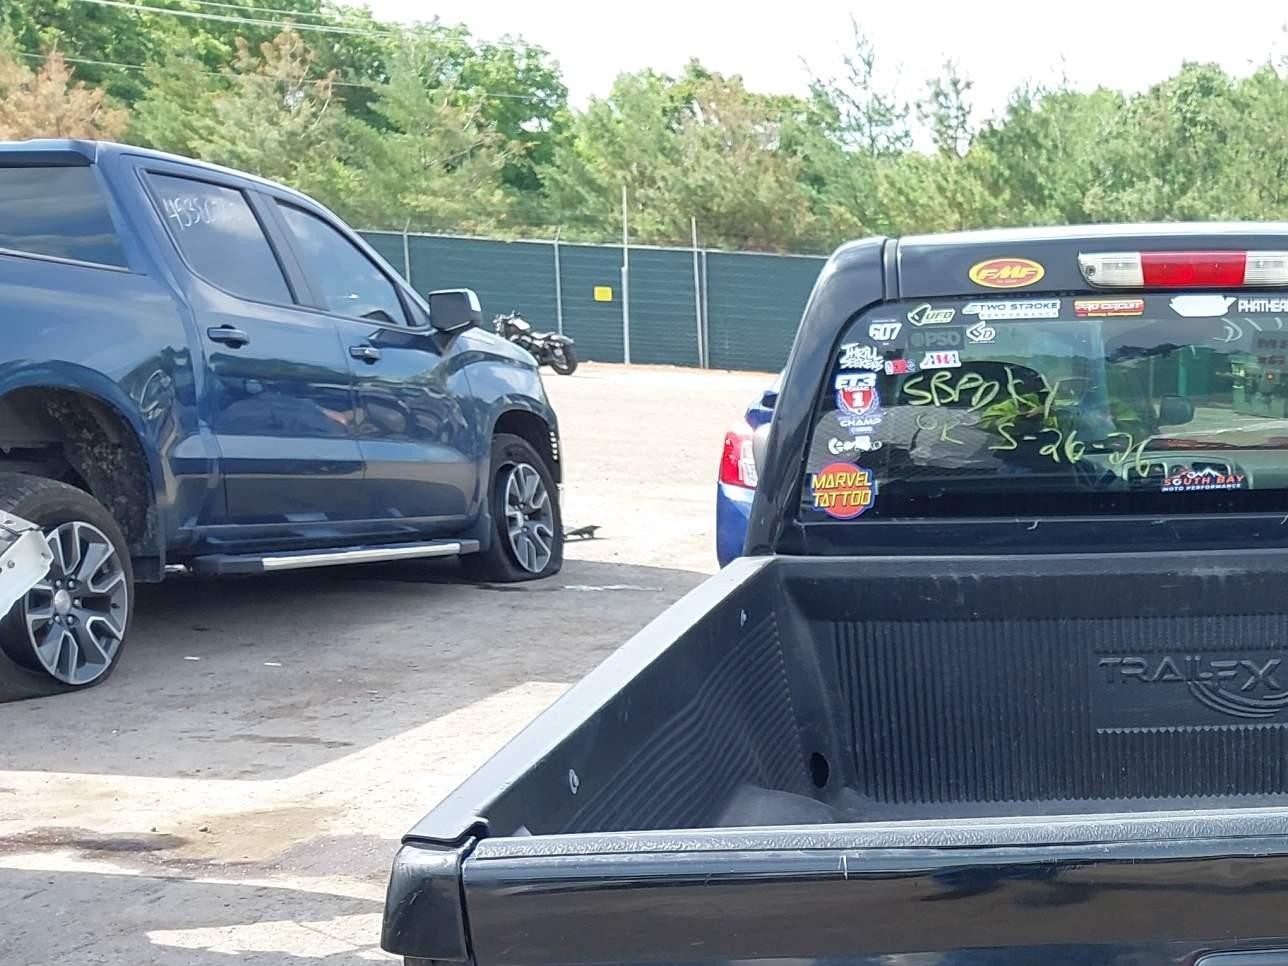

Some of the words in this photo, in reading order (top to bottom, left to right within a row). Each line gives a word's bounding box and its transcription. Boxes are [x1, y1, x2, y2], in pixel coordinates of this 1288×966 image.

[977, 265, 1037, 280] FMF
[980, 303, 1007, 311] TWO
[1010, 301, 1059, 311] STROKE
[1075, 302, 1099, 312] PRO
[1101, 301, 1143, 311] CIRCUIT
[868, 322, 903, 341] 607
[840, 342, 883, 361] THRILL
[921, 351, 961, 369] AMA
[835, 373, 877, 390] ET3
[839, 417, 882, 428] CHAMP
[811, 471, 873, 489] MARVEL
[1163, 477, 1211, 487] SOUTH
[1216, 474, 1245, 484] BAY
[1186, 483, 1241, 491] PERFORMANCE
[812, 489, 873, 508] TATTOO
